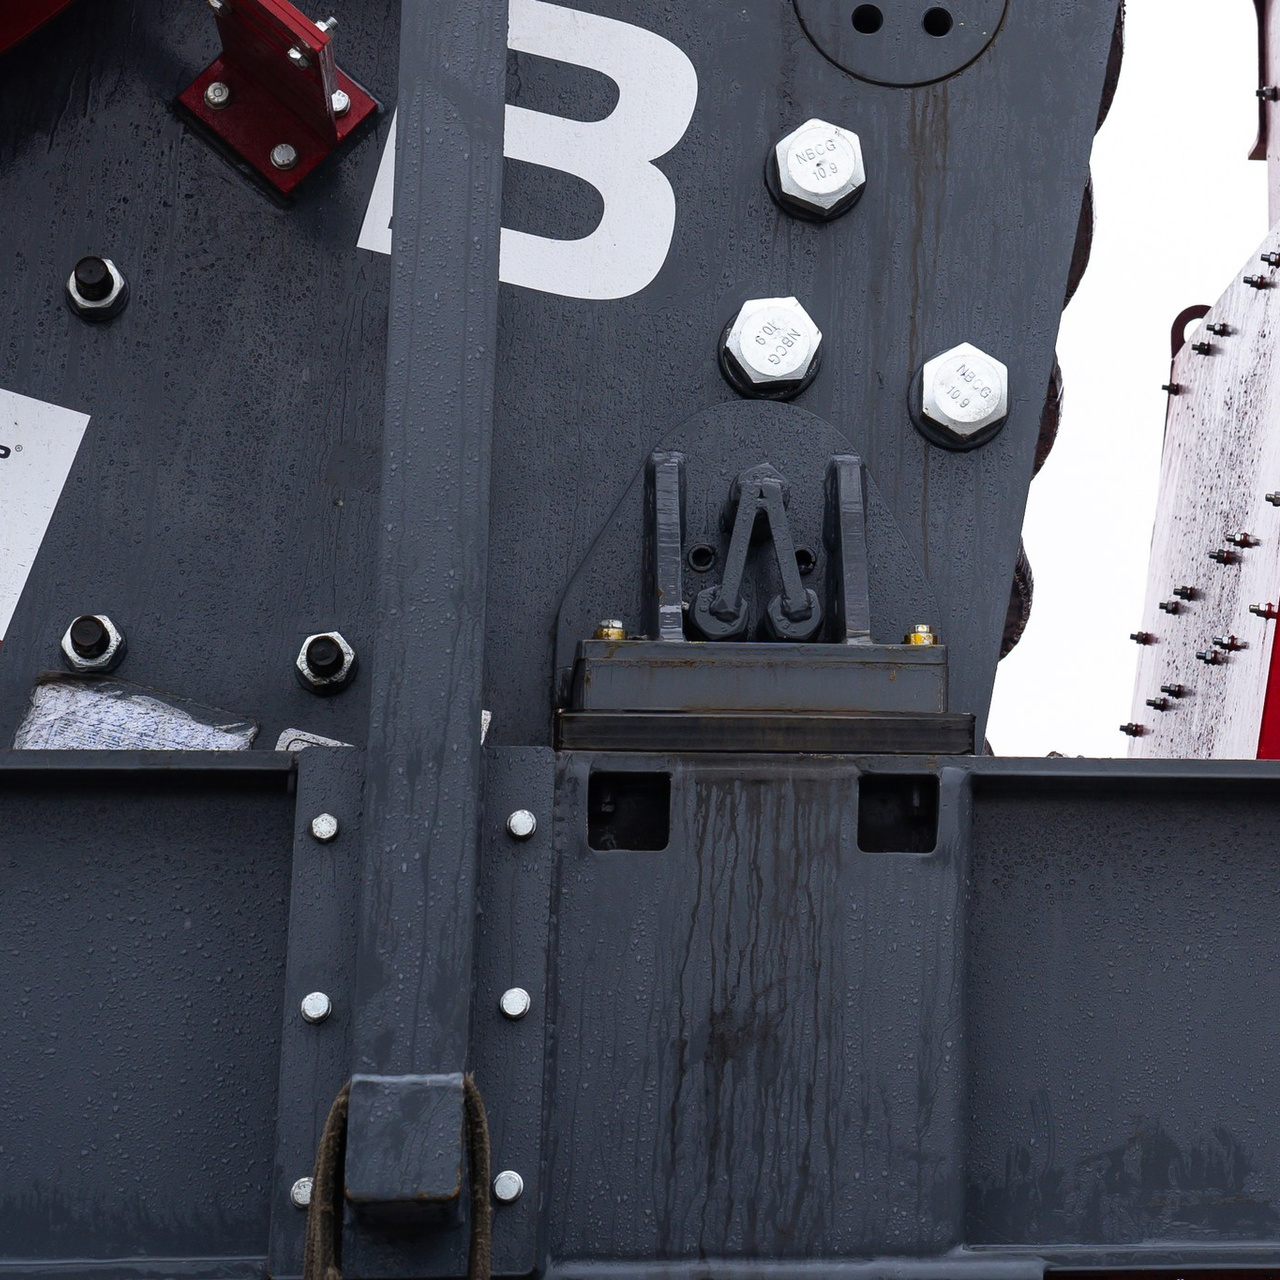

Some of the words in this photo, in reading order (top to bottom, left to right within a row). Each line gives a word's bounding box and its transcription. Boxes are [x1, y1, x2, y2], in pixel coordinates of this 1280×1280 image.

[795, 139, 837, 165] NBCG
[812, 162, 839, 181] 10.9
[755, 321, 779, 346] 10.9
[767, 328, 802, 365] NBCG
[956, 364, 992, 399] NBCG
[946, 385, 971, 408] 10.9
